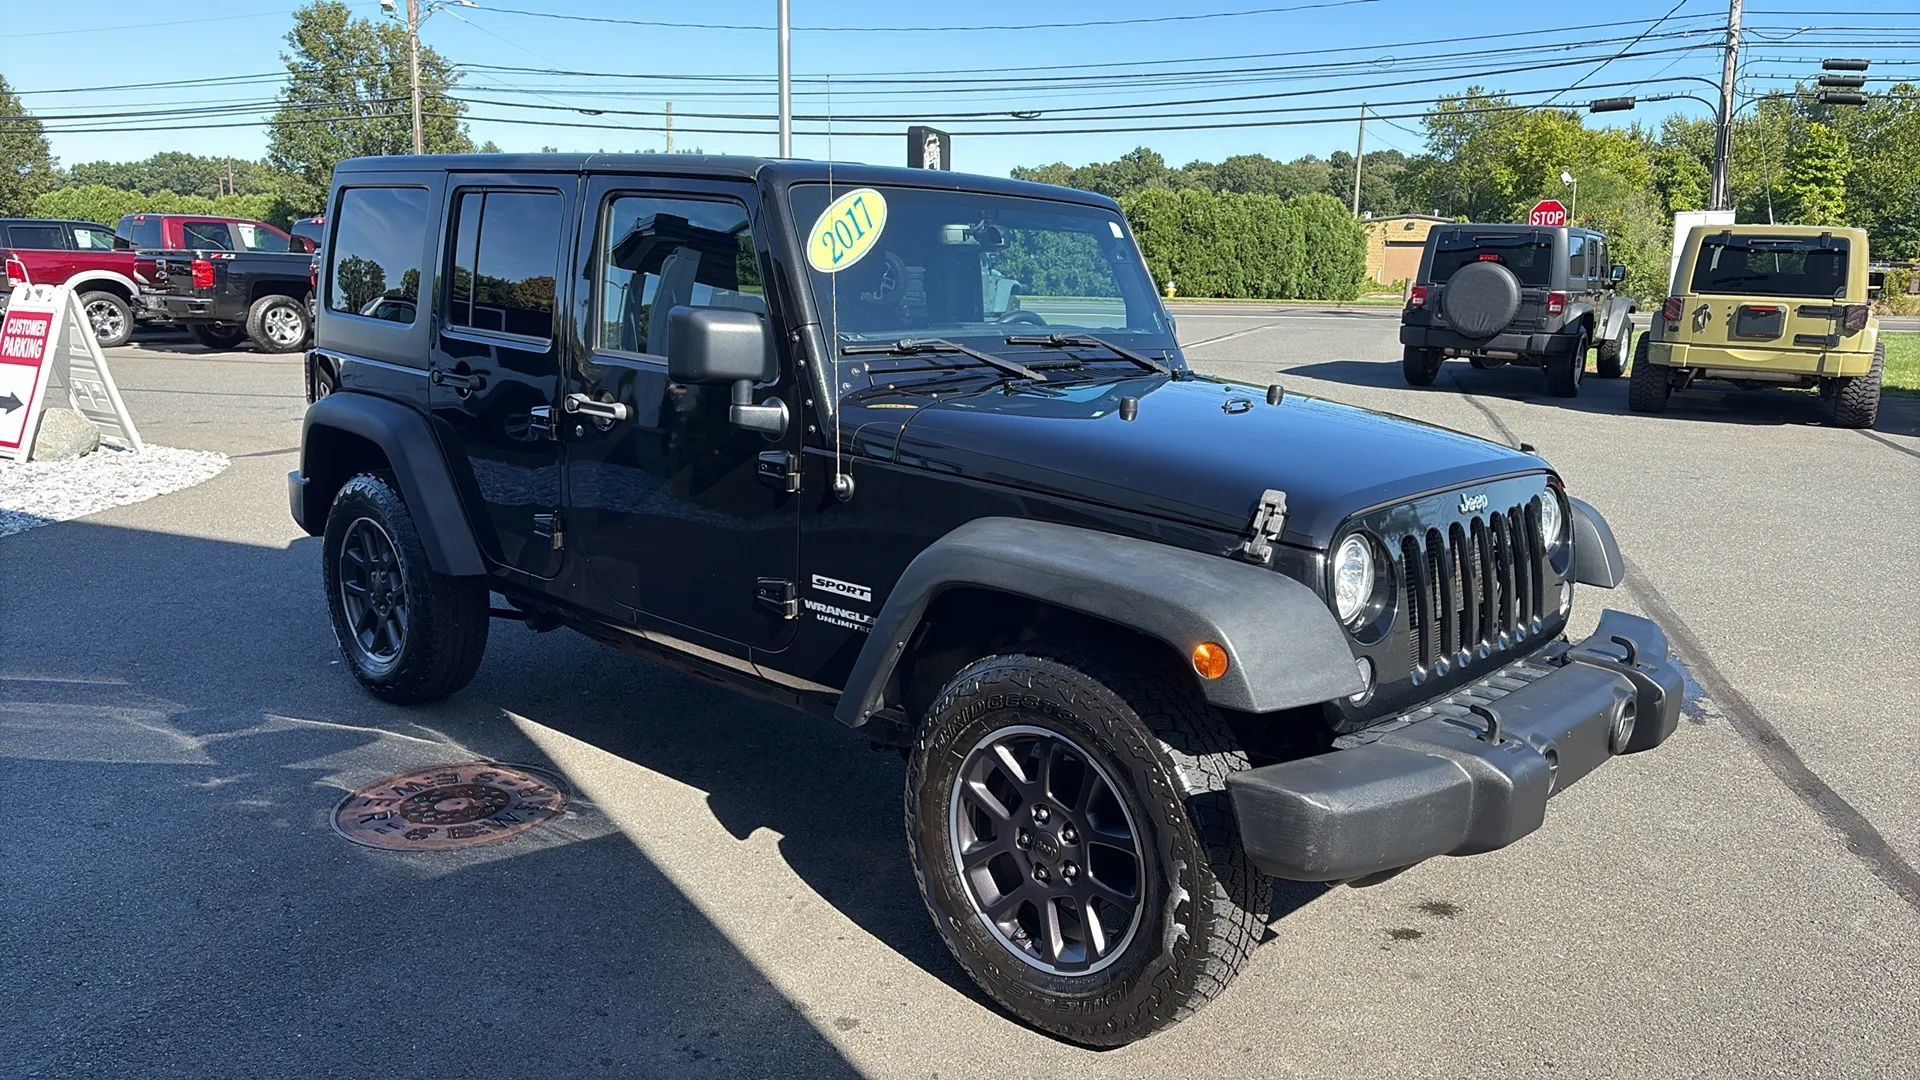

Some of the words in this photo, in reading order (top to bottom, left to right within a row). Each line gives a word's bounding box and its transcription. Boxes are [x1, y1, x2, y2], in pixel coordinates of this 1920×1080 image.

[1531, 211, 1564, 226] STOP
[822, 196, 873, 264] 2017
[7, 318, 48, 337] CUSTOMER
[1, 336, 44, 359] PARKING
[1459, 493, 1488, 513] Jeep
[815, 578, 868, 597] SPORT
[804, 599, 875, 625] WRANGLE
